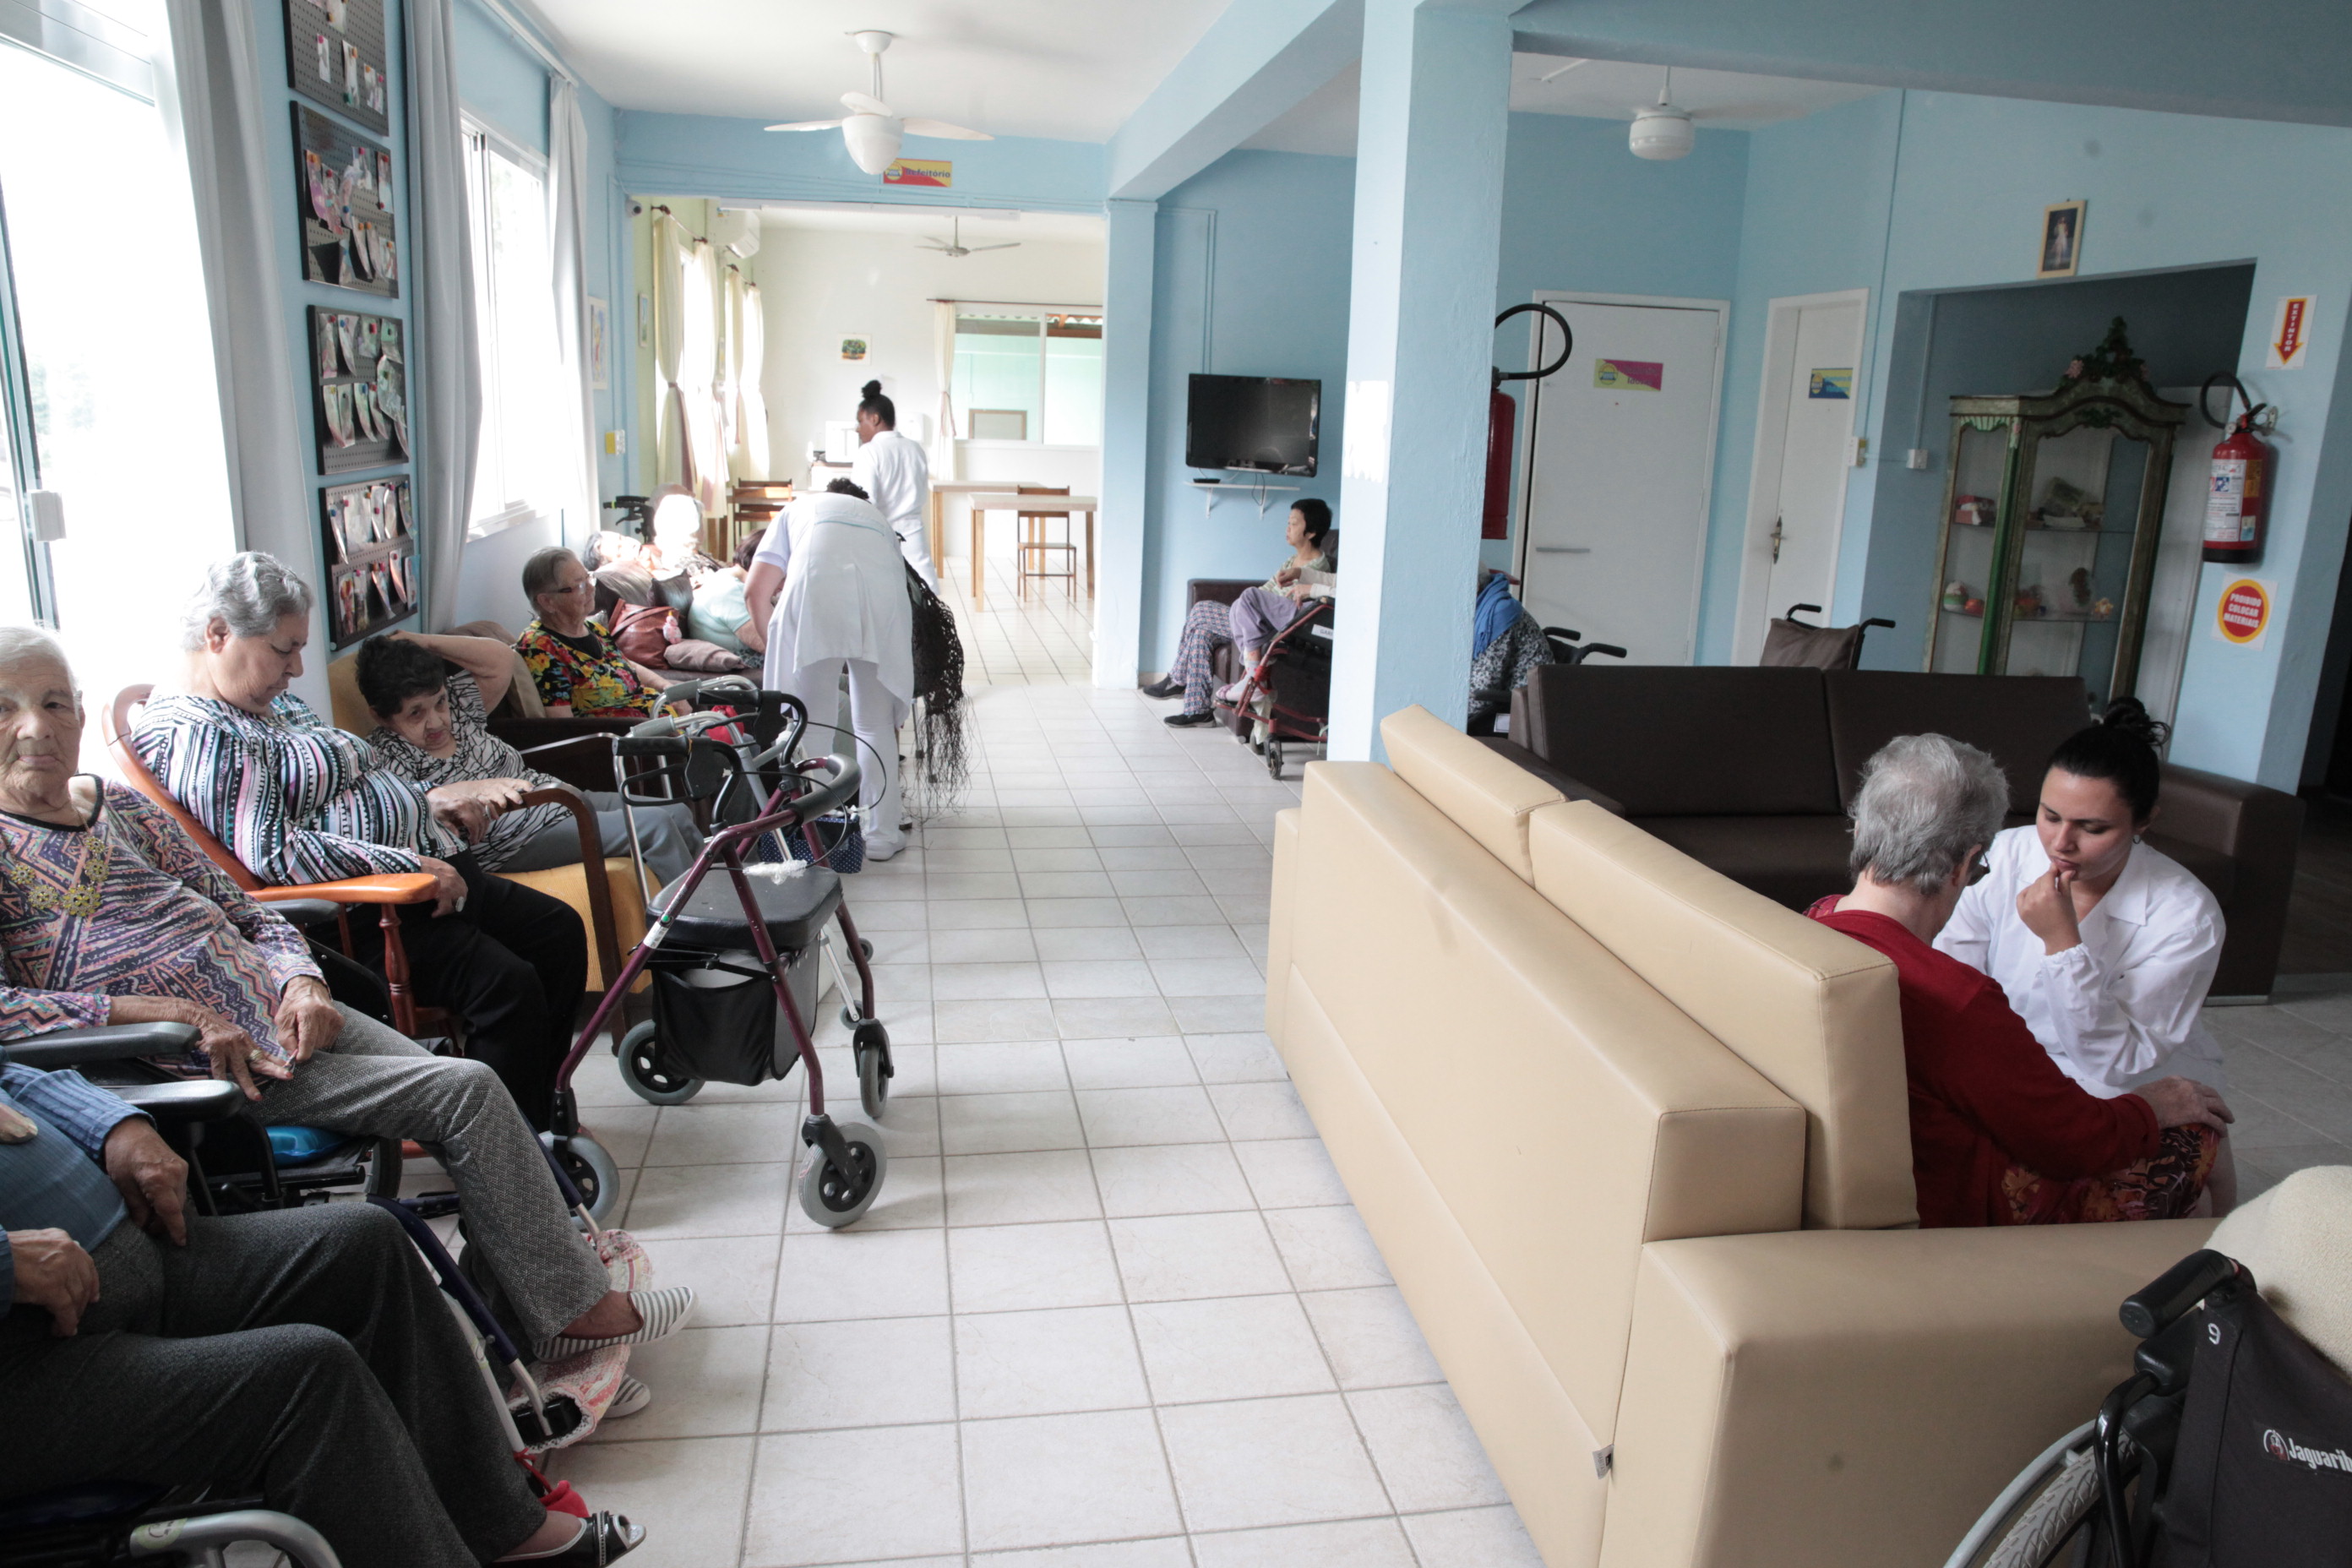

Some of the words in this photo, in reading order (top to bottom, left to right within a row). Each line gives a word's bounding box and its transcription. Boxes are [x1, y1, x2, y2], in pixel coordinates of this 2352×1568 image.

[906, 168, 950, 177] Refeitório
[2284, 303, 2300, 351] EXTINTOR
[2230, 593, 2262, 607] PROIBIDO
[2228, 603, 2259, 618] COLOCAR
[2223, 612, 2259, 629] MATERIAIS
